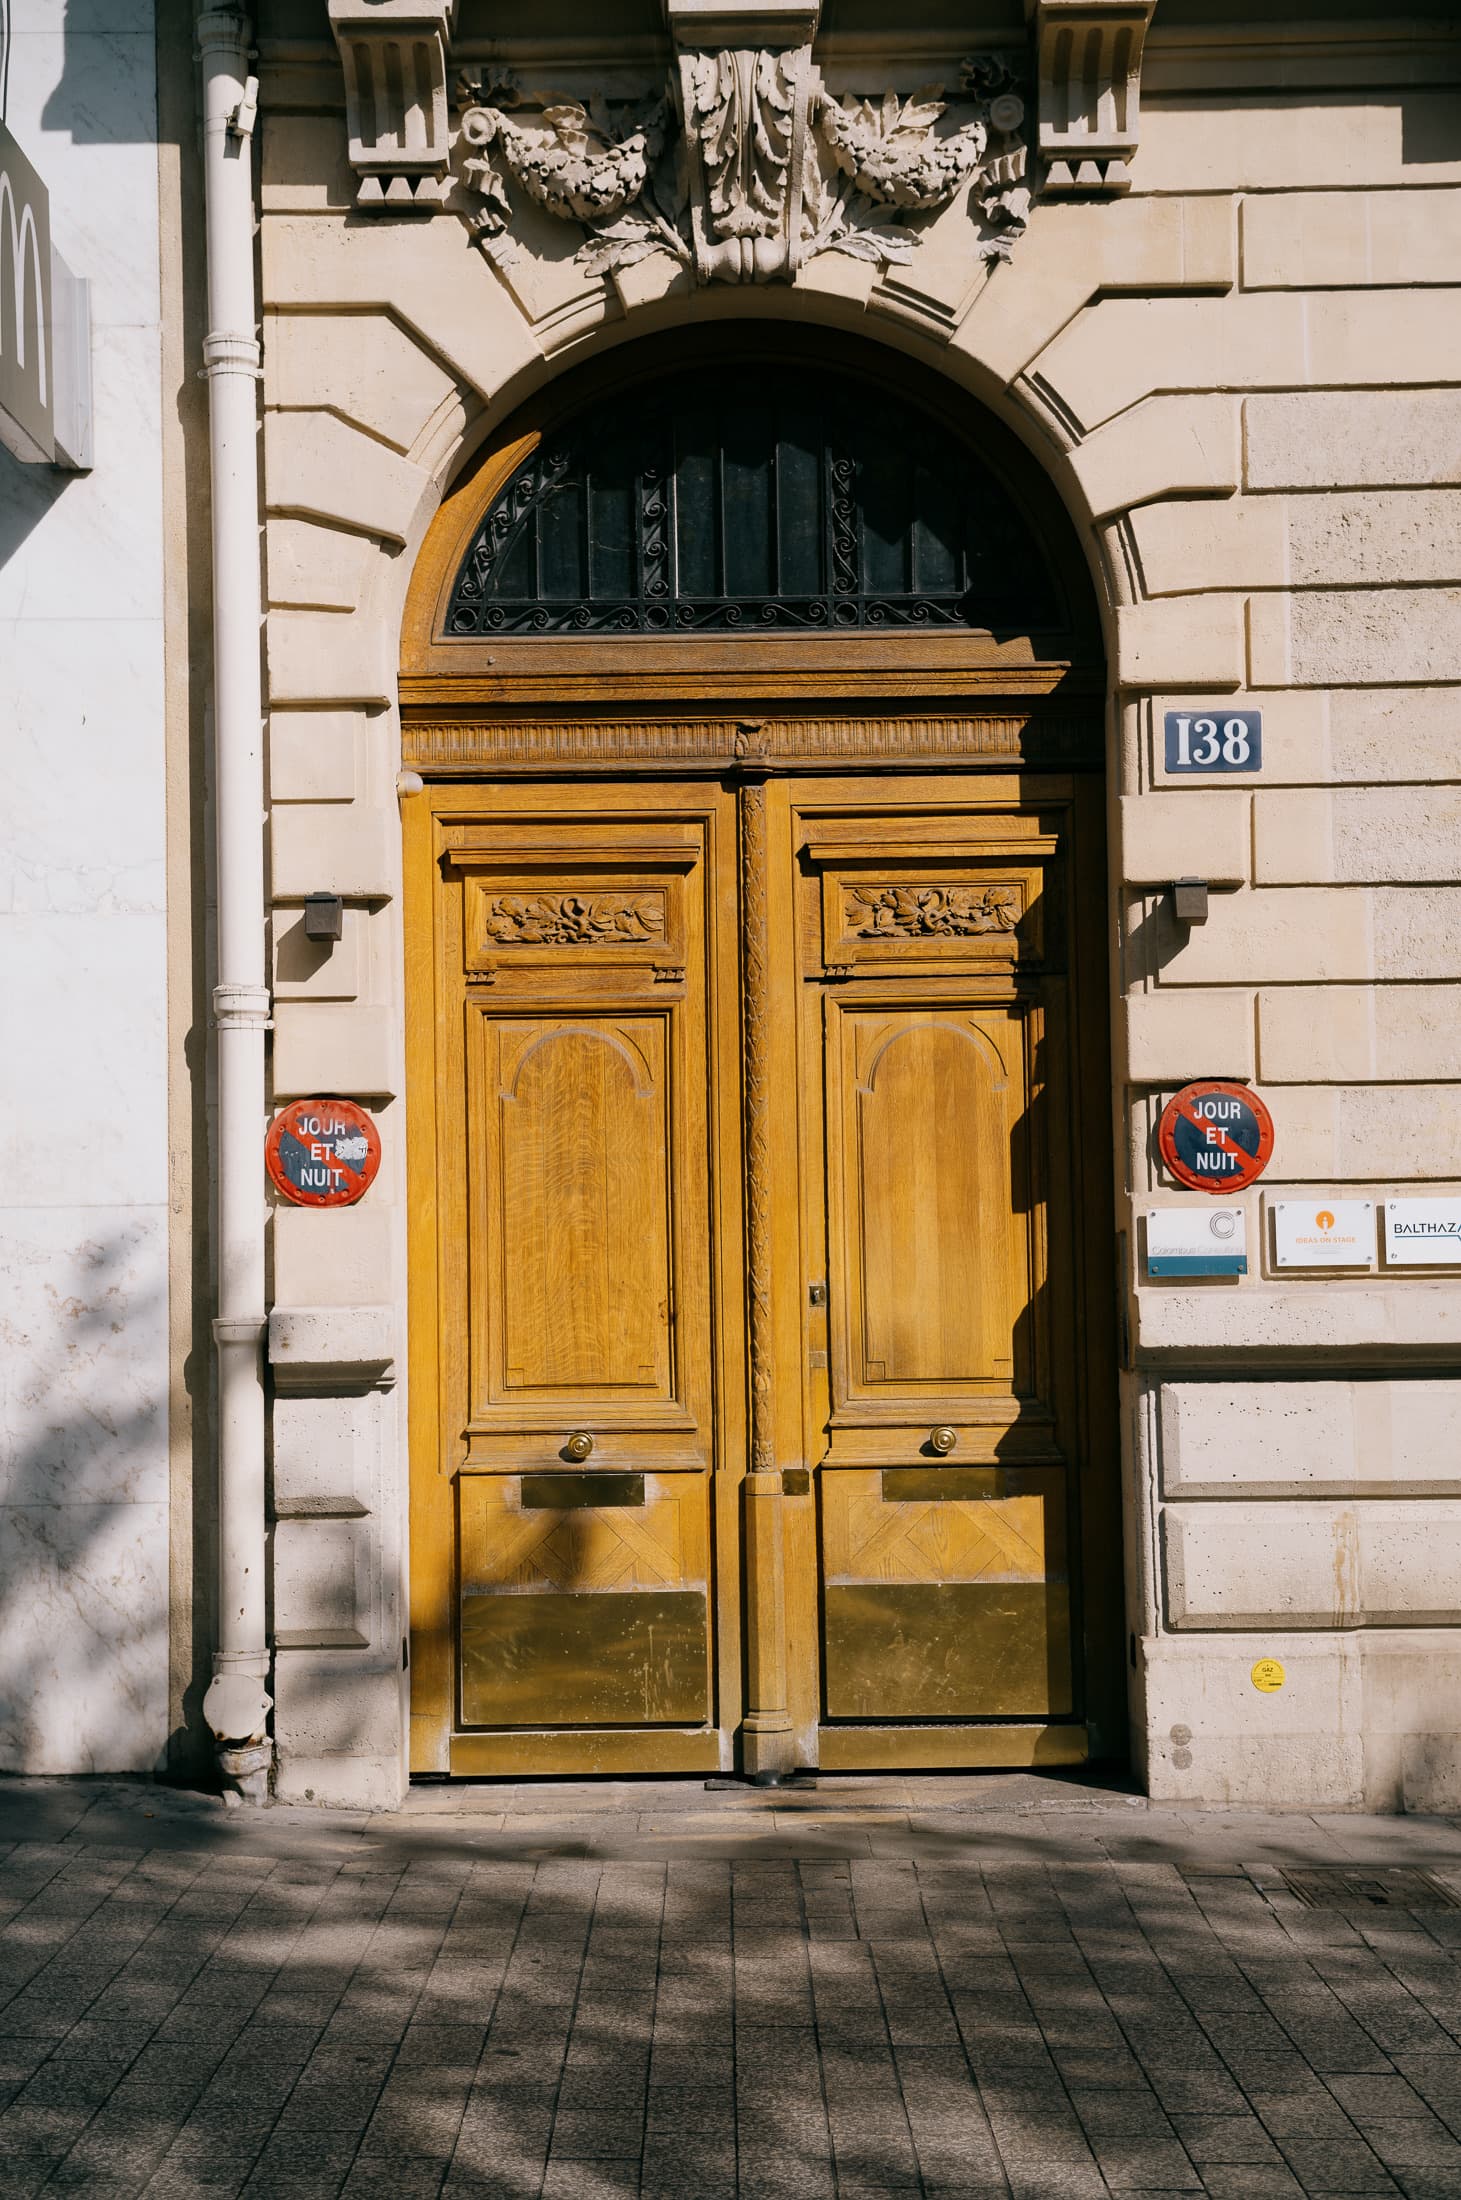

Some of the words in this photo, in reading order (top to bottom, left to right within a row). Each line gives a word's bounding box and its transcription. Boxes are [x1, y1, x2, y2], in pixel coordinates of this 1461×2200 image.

[1176, 718, 1250, 765] 138
[1193, 1101, 1241, 1120] JOUR
[298, 1117, 346, 1136] JOUR
[1206, 1127, 1228, 1145] ET
[310, 1143, 334, 1161] ET
[1196, 1152, 1239, 1171] NUIT
[300, 1169, 344, 1187] NUIT
